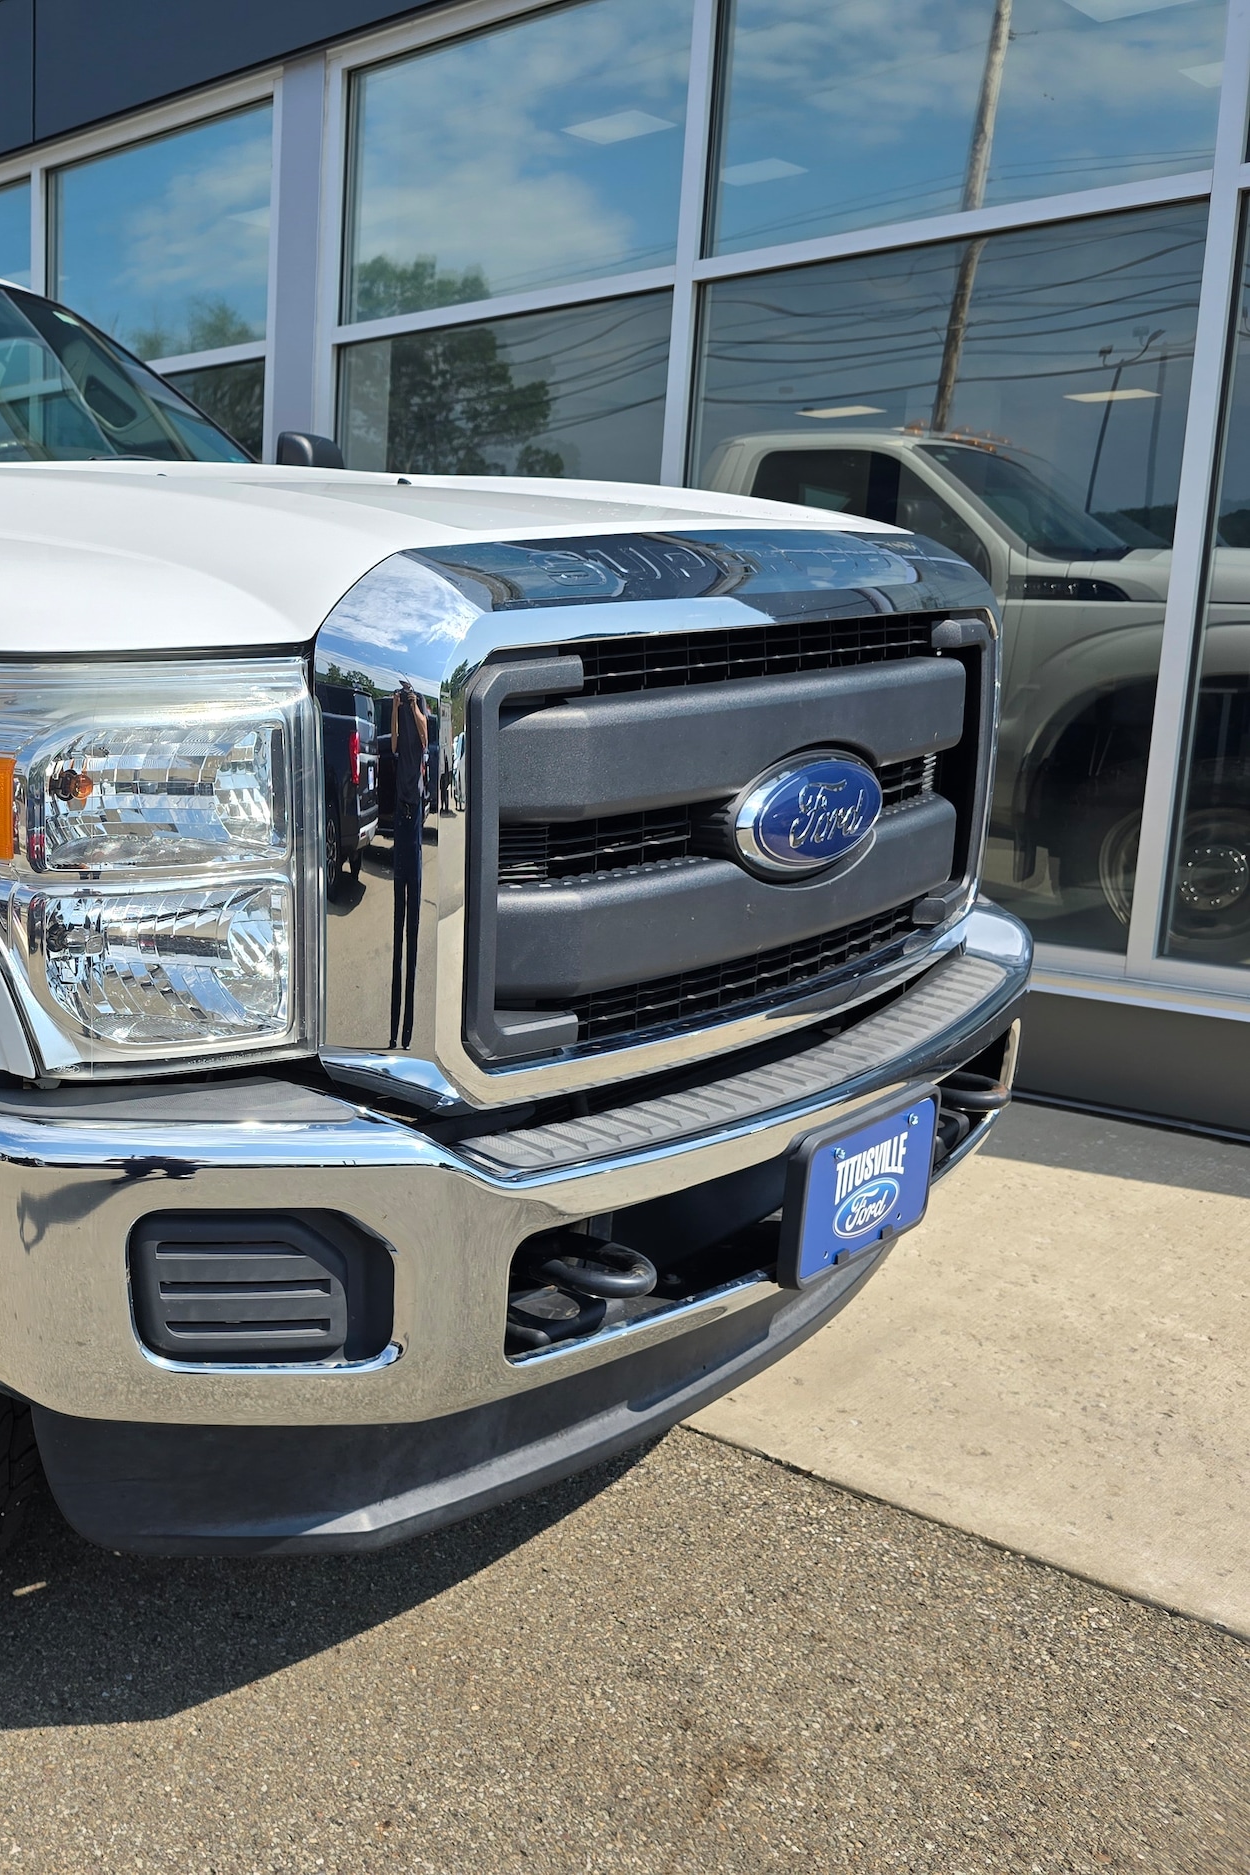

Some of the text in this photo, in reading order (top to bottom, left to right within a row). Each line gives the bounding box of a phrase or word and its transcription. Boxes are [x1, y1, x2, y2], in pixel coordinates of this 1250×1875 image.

[788, 779, 865, 848] Ford
[834, 1131, 908, 1206] TITUSVILLE
[845, 1187, 889, 1232] Ford
